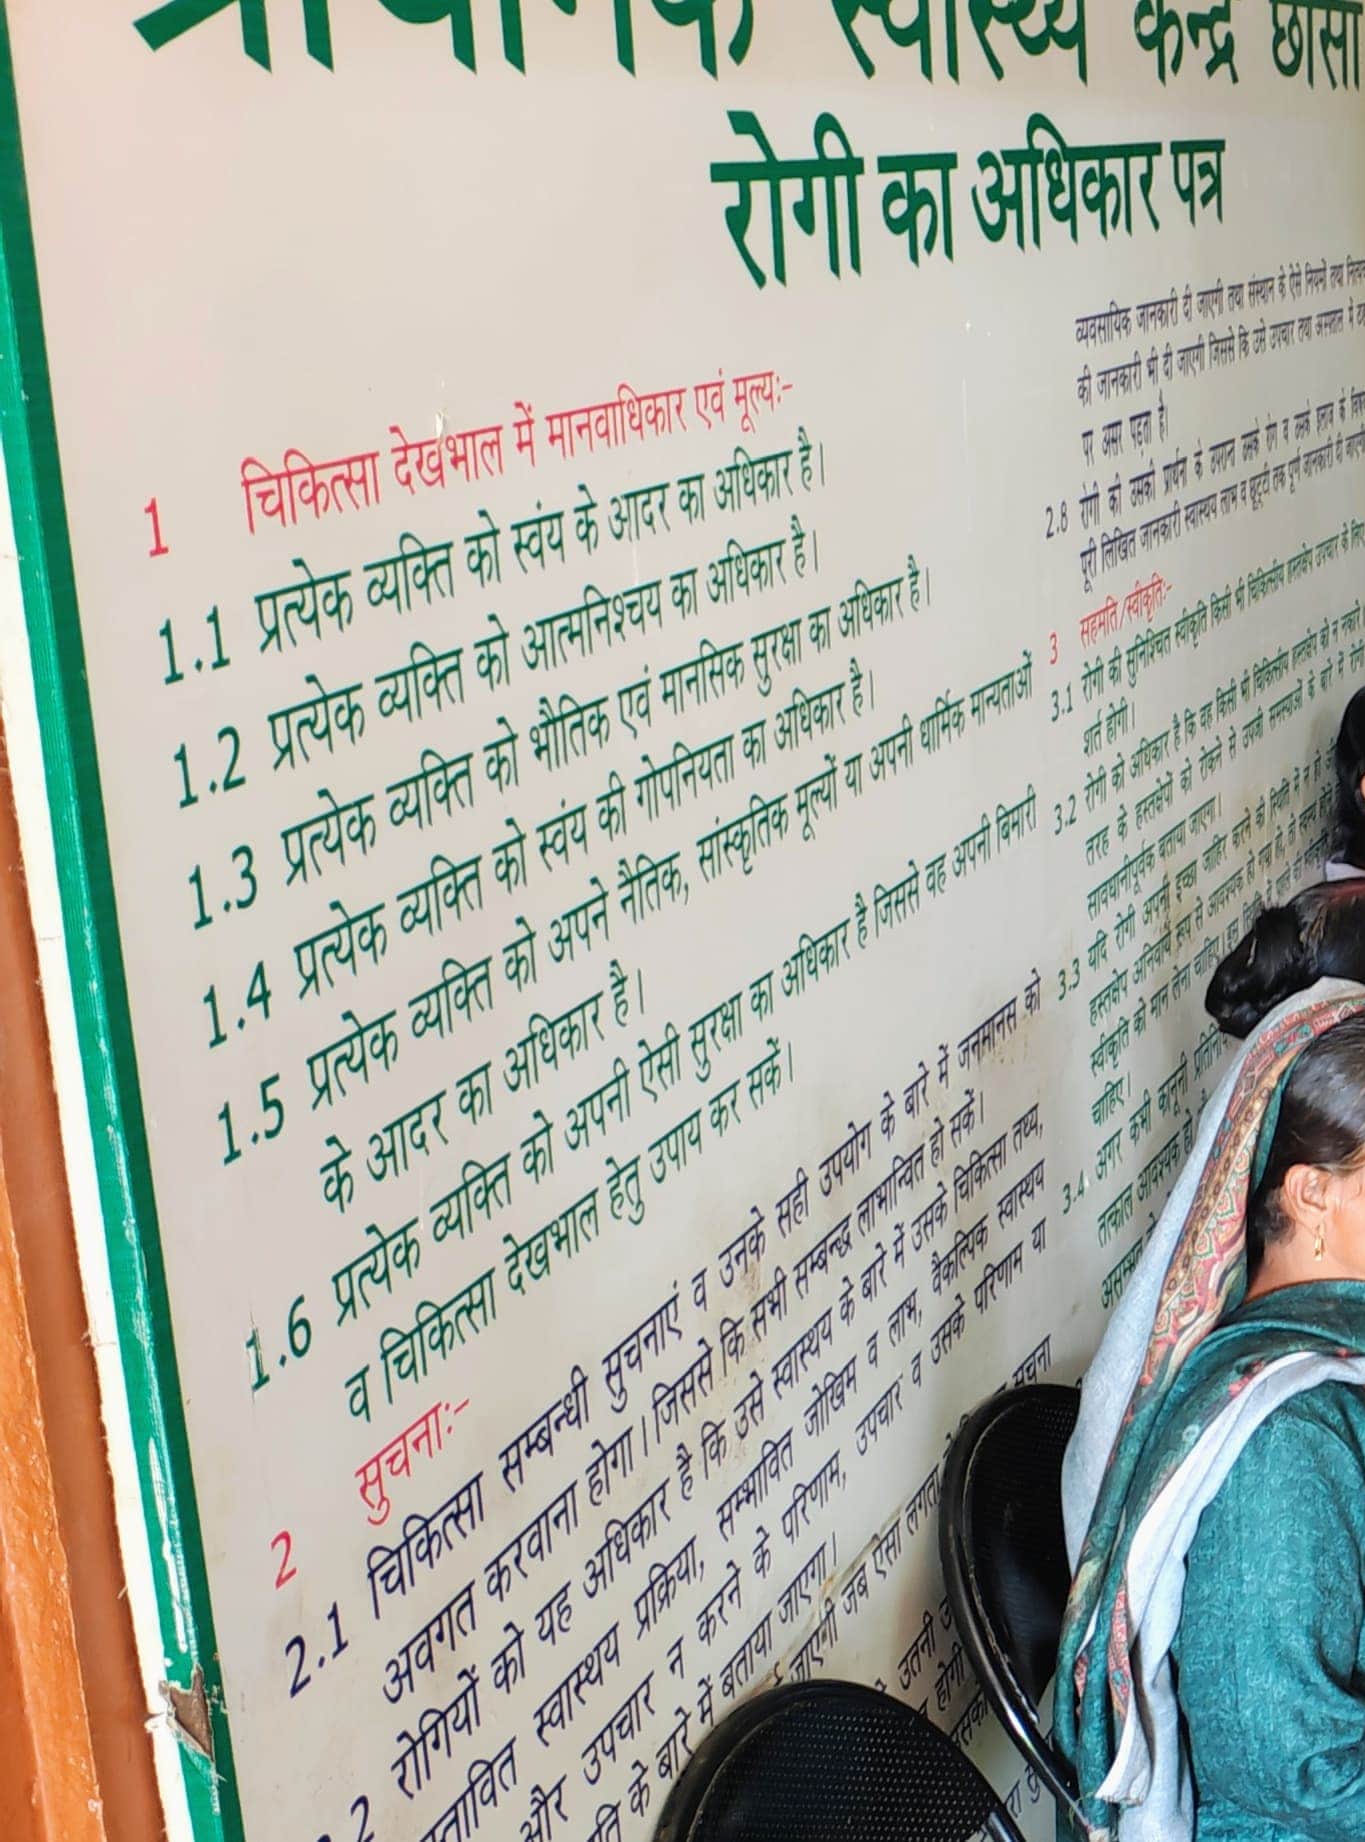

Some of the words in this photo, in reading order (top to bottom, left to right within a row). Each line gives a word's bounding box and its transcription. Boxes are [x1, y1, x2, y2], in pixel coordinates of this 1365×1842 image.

[709, 110, 865, 290] रोगी
[877, 152, 958, 268] का
[971, 112, 1162, 252] अधिकार
[1170, 139, 1226, 227] पत्र
[144, 497, 169, 557] 1
[241, 448, 380, 535] चिकित्सा
[389, 425, 503, 494] देखभाल
[513, 401, 535, 466] में
[545, 384, 687, 457] मानवाधिकार
[694, 367, 725, 429] एवं
[159, 605, 230, 685] 1.1
[254, 558, 353, 653] प्रत्येक
[363, 532, 454, 614] व्यक्ति
[464, 509, 501, 588] को
[573, 484, 598, 555] के
[608, 482, 670, 541] आदर
[677, 473, 705, 524] का
[714, 446, 793, 512] अधिकार
[174, 726, 246, 809] 1.2
[267, 674, 365, 771] प्रत्येक
[374, 641, 464, 722] व्यक्ति
[473, 613, 510, 691] को
[521, 579, 662, 670] आत्मनिश्चय
[670, 568, 698, 619] का
[706, 539, 786, 604] अधिकार
[188, 845, 257, 930] 1.3
[280, 788, 376, 886] प्रत्येक
[385, 748, 474, 829] व्यक्ति
[483, 716, 519, 793] को
[529, 694, 610, 771] भौतिक
[617, 665, 652, 739] एवं
[659, 638, 744, 715] मानसिक
[750, 618, 802, 697] सुरक्षा
[808, 606, 831, 653] का
[838, 576, 904, 638] अधिकार
[1049, 631, 1059, 665] 3
[218, 1073, 284, 1166] 1.5
[306, 1009, 398, 1111] प्रत्येक
[408, 955, 493, 1038] व्यक्ति
[502, 916, 536, 992] को
[548, 876, 609, 963] अपने
[617, 851, 688, 924] नैतिक,
[696, 793, 788, 883] सांस्कृतिक
[794, 753, 838, 841] मूल्यों
[844, 753, 863, 796] या
[869, 713, 913, 781] अपनी
[920, 689, 965, 754] धार्मिक
[969, 650, 1032, 725] मान्यताओं
[246, 1294, 312, 1392] 1.6
[331, 1216, 420, 1327] प्रत्येक
[429, 1152, 511, 1242] व्यक्ति
[520, 1109, 553, 1184] को
[565, 1057, 630, 1151] अपनी
[637, 1022, 680, 1103] ऐसी
[688, 991, 742, 1083] सुरक्षा
[749, 970, 774, 1021] का
[781, 918, 851, 997] अधिकार
[855, 892, 868, 949] है
[873, 859, 920, 938] जिससे
[925, 853, 946, 897] वह
[952, 813, 991, 877] अपनी
[996, 784, 1036, 853] बिमारी
[320, 1135, 354, 1213] के
[367, 1089, 448, 1182] आदर
[456, 1061, 492, 1125] का
[503, 991, 604, 1092] अधिकार
[285, 1601, 348, 1698] 2.1
[367, 1471, 484, 1620] चिकित्सा
[498, 1365, 589, 1493] सम्बन्धी
[692, 1268, 707, 1311] व
[718, 1205, 765, 1288] उनके
[775, 1167, 809, 1238] सही
[819, 1121, 872, 1197] उपयोग
[880, 1091, 895, 1140] के
[904, 1061, 930, 1118] बारे
[938, 1044, 949, 1088] में
[345, 1364, 371, 1423] व
[380, 1267, 496, 1404] चिकित्सा
[503, 1187, 599, 1296] देखभाल
[605, 1155, 645, 1226] हेतु
[648, 1108, 702, 1184] उपाय
[708, 1079, 741, 1137] कर
[271, 1531, 296, 1589] 2
